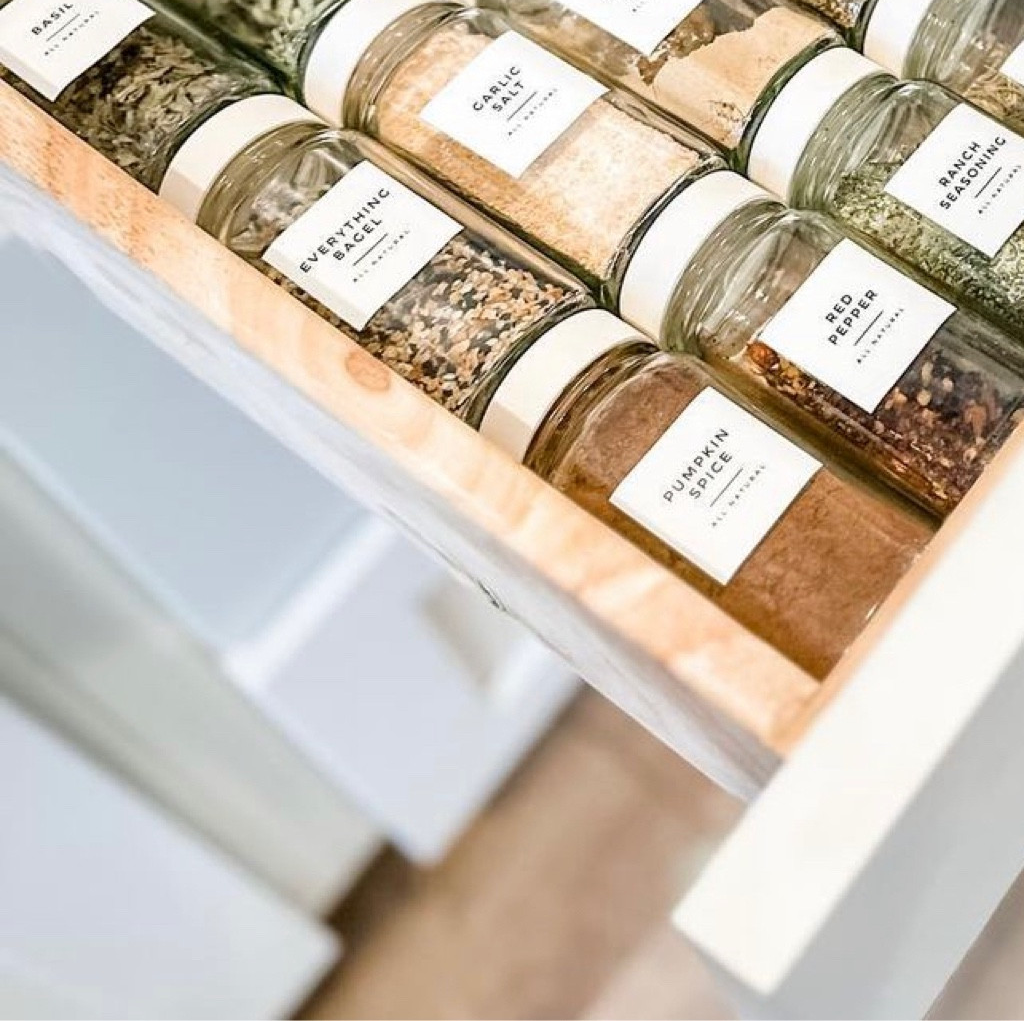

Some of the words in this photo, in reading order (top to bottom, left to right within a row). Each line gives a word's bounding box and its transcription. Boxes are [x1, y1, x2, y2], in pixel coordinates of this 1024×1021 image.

[31, 3, 74, 36] BASIL
[472, 66, 521, 111] GARLIC
[492, 80, 524, 112] SALT
[938, 141, 981, 187] RANCH
[939, 136, 1006, 210] SEASONING
[299, 188, 390, 274] EVERYTHING
[332, 218, 383, 261] BAGEL
[825, 294, 853, 324] RED
[828, 289, 878, 346] PEPPER
[663, 428, 730, 503] PUMPKIN
[688, 450, 733, 500] SPICE
